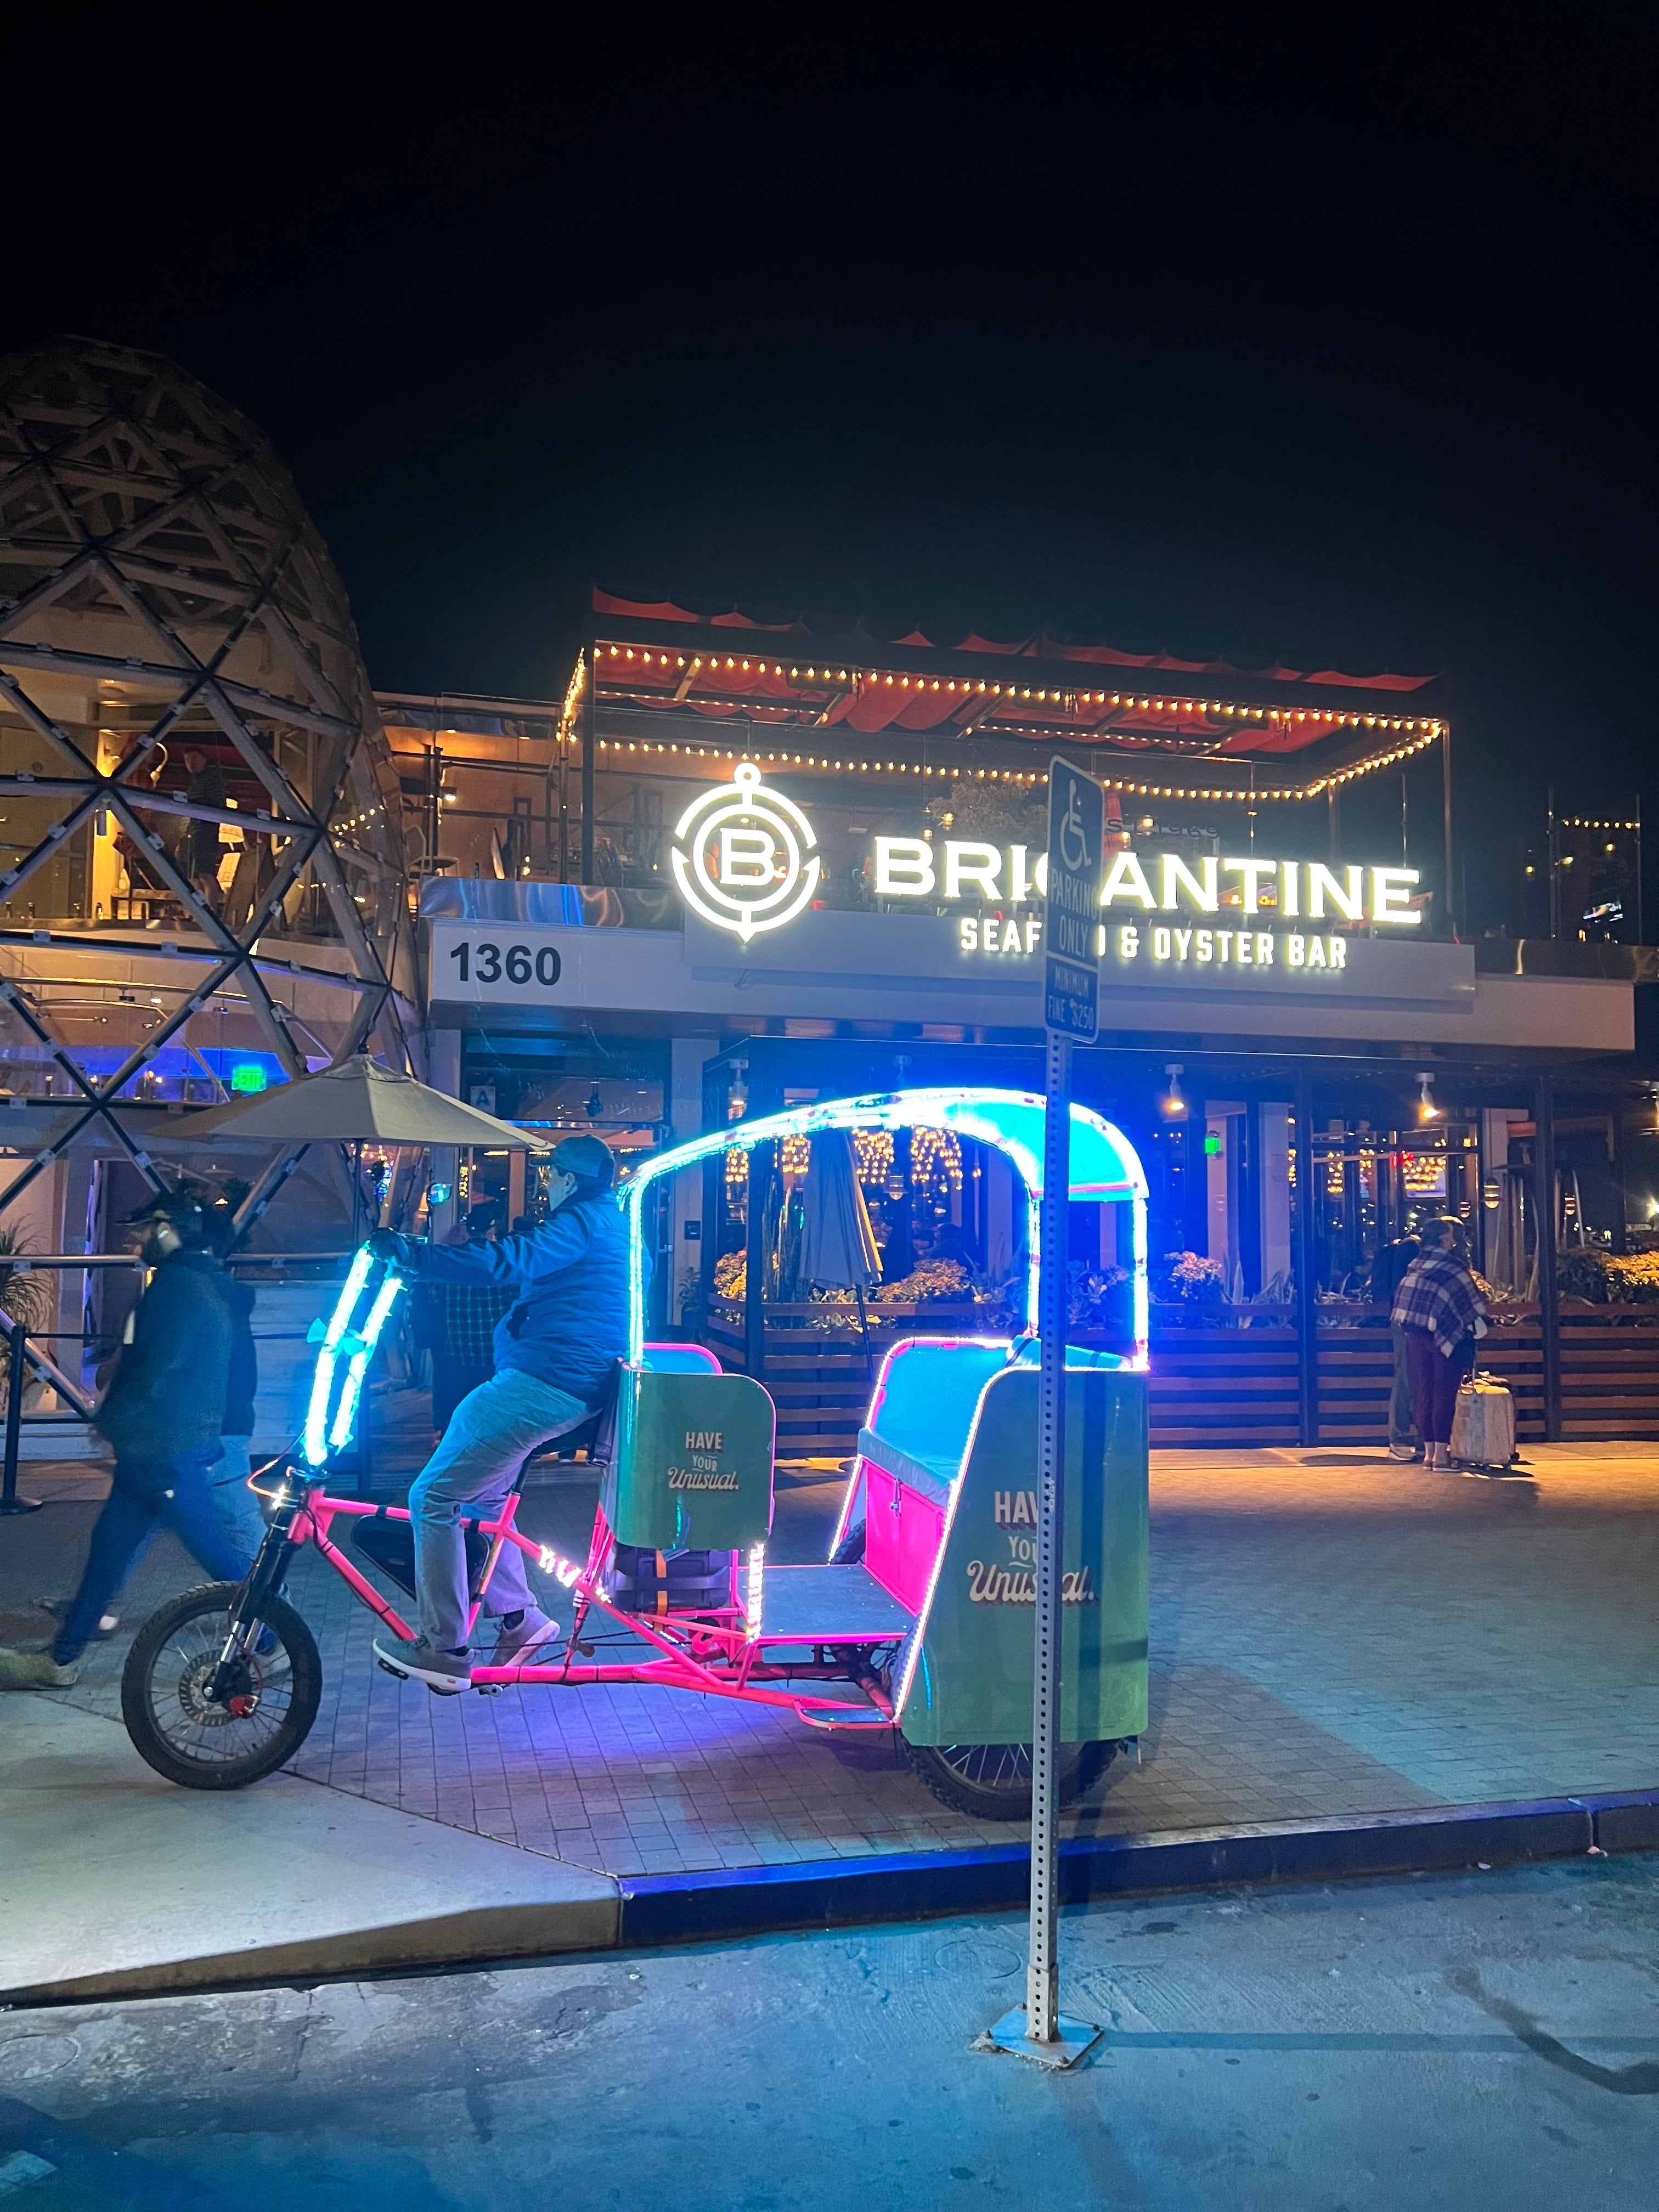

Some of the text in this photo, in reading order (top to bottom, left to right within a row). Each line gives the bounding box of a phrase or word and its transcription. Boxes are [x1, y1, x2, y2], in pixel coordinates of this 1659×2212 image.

[719, 828, 775, 886] B
[874, 836, 1421, 924] BRIANTINE
[1051, 868, 1098, 921] PARKING
[961, 917, 1346, 968] SEAF & OYSTER BAR
[1059, 915, 1088, 958] ONLY
[450, 942, 561, 985] 1360
[1054, 966, 1089, 998] MINIMUM
[1048, 995, 1094, 1030] FINE $250
[239, 1072, 262, 1089] EXIT
[476, 1090, 490, 1105] A
[686, 1431, 723, 1451] HAVE
[668, 1466, 739, 1490] Unusual.
[692, 1454, 718, 1472] YOUR
[994, 1491, 1038, 1524] HAV
[1008, 1536, 1037, 1564] YO
[966, 1560, 1095, 1602] Unusal.
